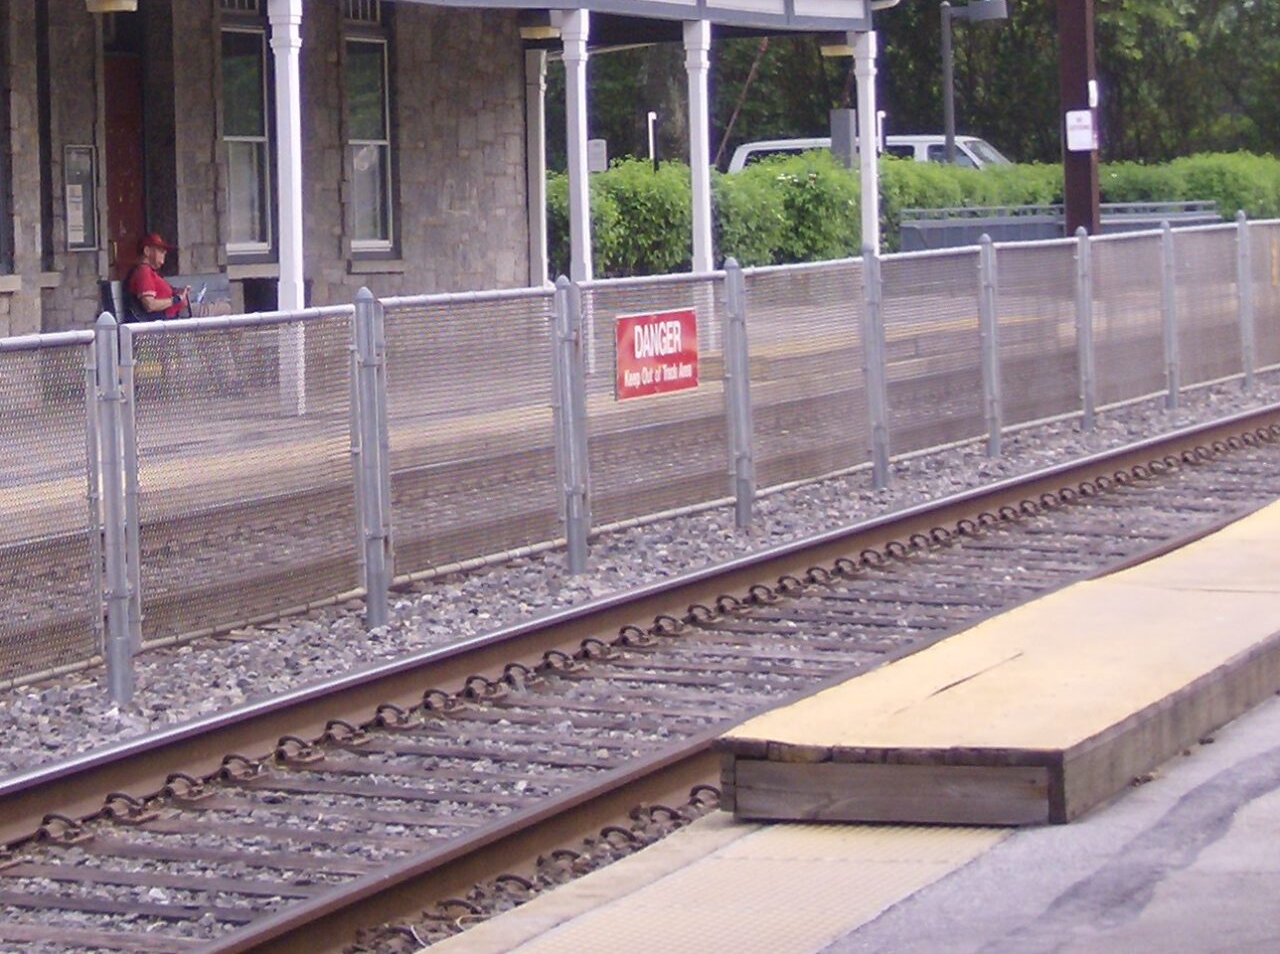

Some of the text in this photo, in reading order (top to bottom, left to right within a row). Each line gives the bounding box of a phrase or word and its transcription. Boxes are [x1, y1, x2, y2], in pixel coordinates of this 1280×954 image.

[635, 321, 682, 358] DANGER
[624, 370, 640, 389] Keep
[642, 367, 653, 385] Out
